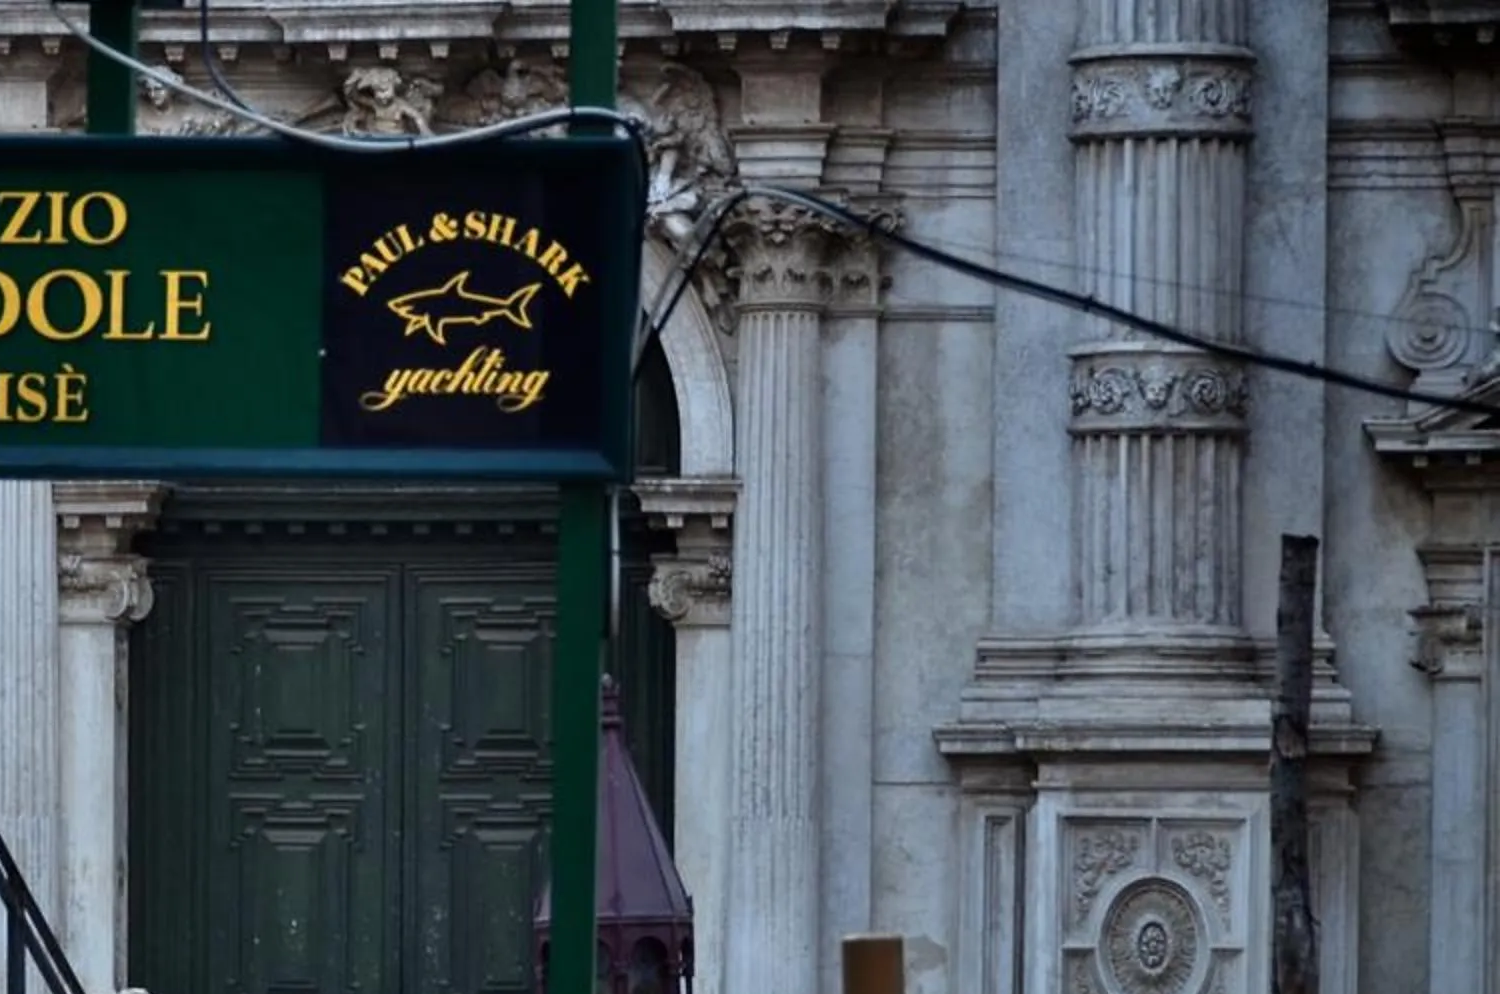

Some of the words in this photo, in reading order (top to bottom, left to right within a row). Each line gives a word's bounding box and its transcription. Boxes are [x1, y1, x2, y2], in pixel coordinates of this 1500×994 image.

[340, 223, 426, 297] PAUL
[428, 211, 459, 243] &
[462, 209, 591, 299] SHARK
[359, 345, 551, 412] yachting
